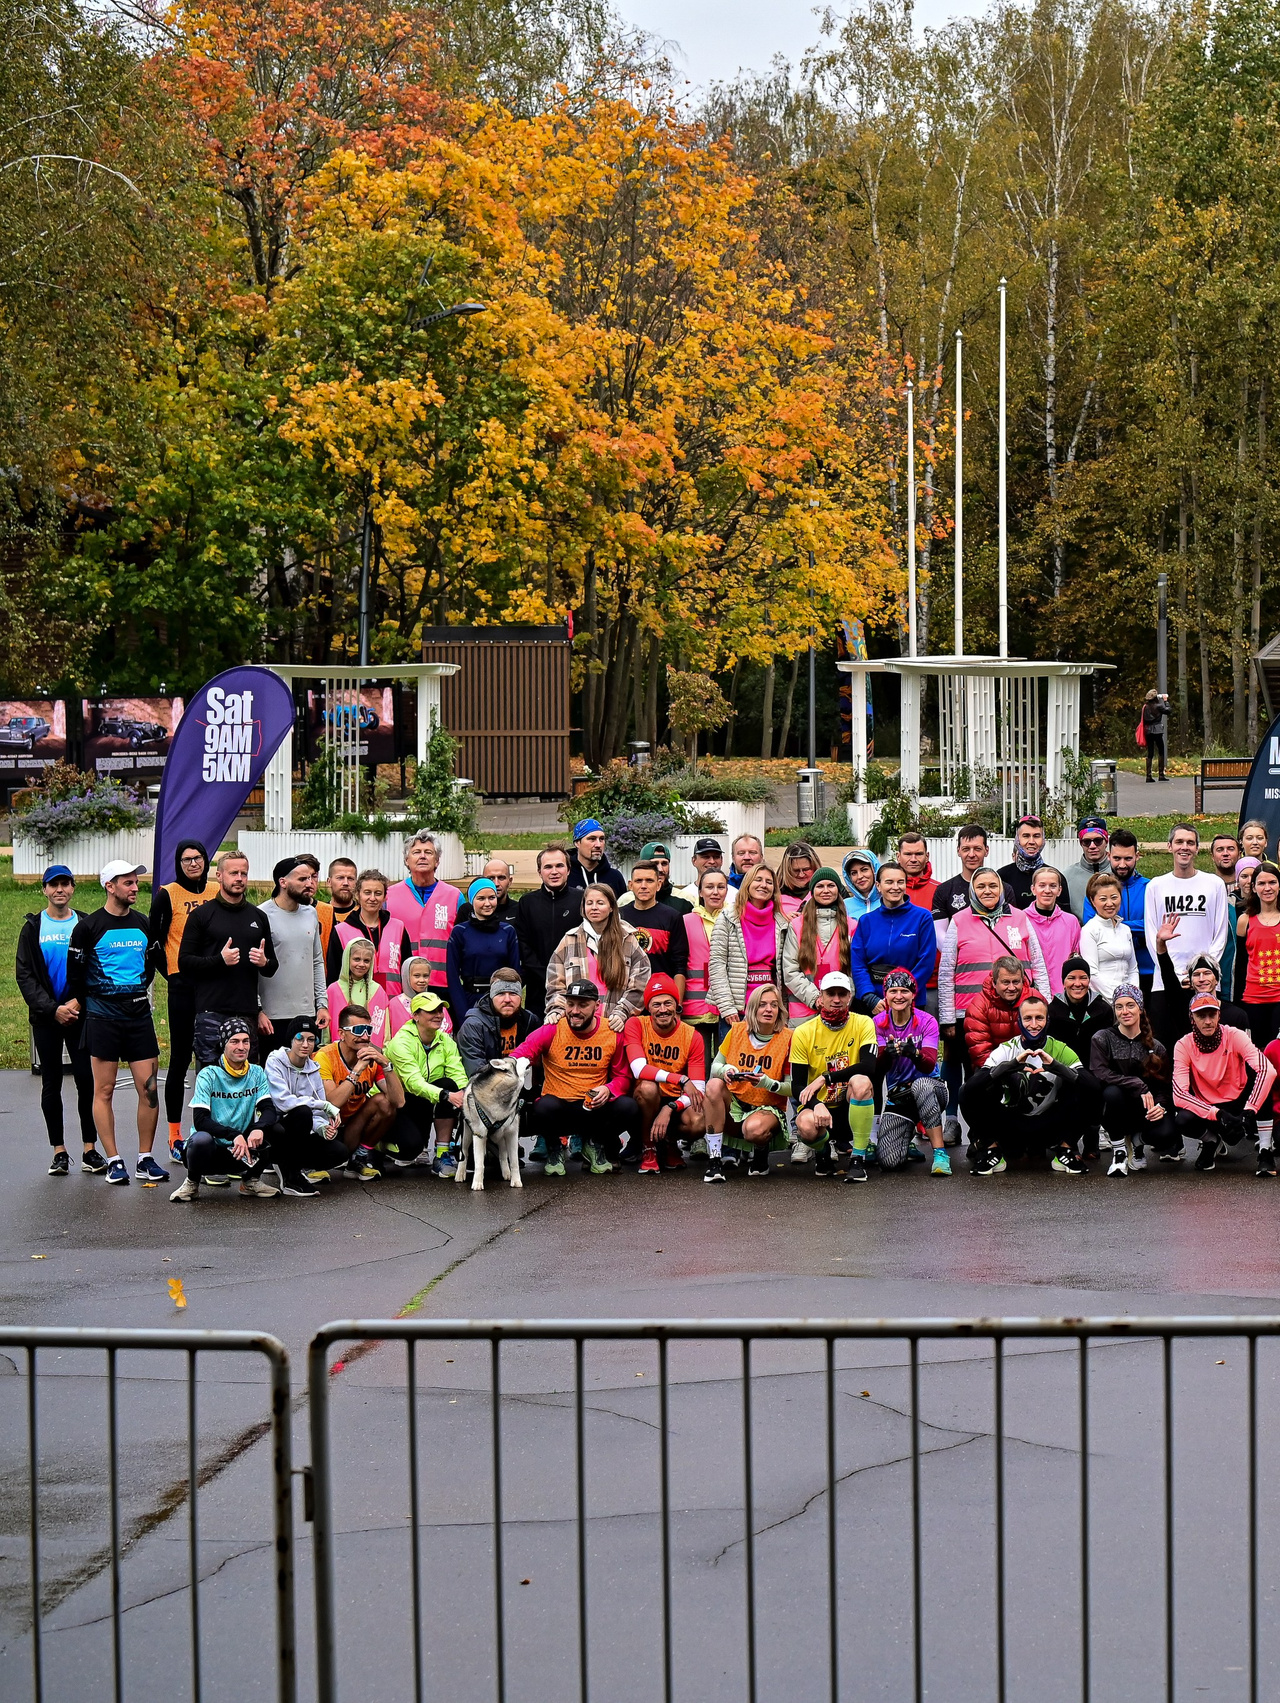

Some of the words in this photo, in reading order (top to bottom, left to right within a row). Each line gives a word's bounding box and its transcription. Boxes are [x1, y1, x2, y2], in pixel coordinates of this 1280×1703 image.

[206, 687, 253, 724] Sat
[204, 724, 253, 753] 9AM
[202, 753, 251, 782] 5KM
[1165, 895, 1206, 913] M42.2
[564, 1046, 602, 1061] 27:30
[648, 1042, 679, 1060] 30:00
